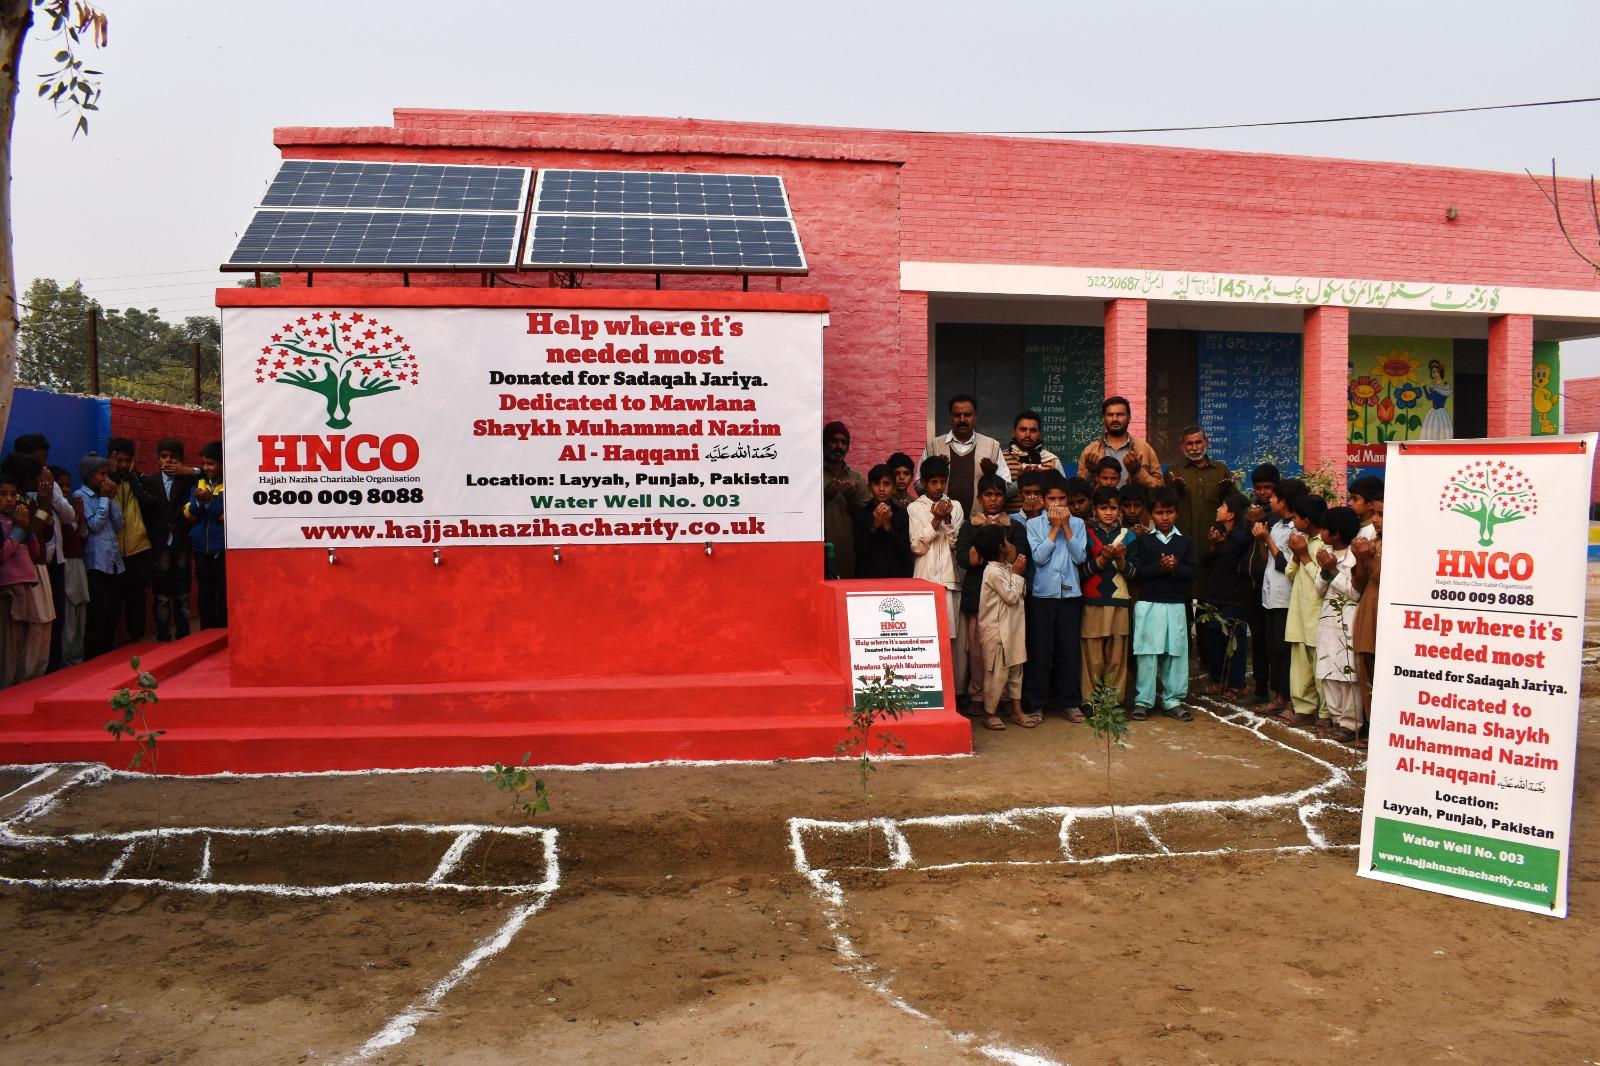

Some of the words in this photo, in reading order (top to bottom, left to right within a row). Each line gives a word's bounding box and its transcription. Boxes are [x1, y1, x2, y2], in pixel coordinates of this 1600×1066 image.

[526, 313, 598, 340] Help
[604, 315, 695, 336] where
[701, 313, 743, 336] it's
[546, 343, 649, 364] needed
[654, 346, 724, 364] most
[489, 371, 574, 385] Donated
[578, 371, 610, 385] for
[614, 371, 697, 389] Sadaqah
[700, 371, 768, 390] Jariya.
[1044, 384, 1064, 392] 1122
[1048, 374, 1061, 384] 15
[499, 393, 617, 411] Dedicated
[621, 395, 645, 411] to
[650, 394, 756, 411] Mawlana
[1043, 394, 1062, 403] 1124
[473, 419, 562, 440] Shaykh
[566, 419, 703, 436] Muhammad
[708, 419, 781, 436] Nazim
[258, 434, 419, 472] HNCO
[558, 444, 586, 461] Al
[603, 443, 699, 465] Haqqani
[259, 476, 287, 485] Hajjah
[366, 475, 420, 484] Organisation
[467, 474, 554, 486] Location:
[560, 474, 629, 488] Layyah,
[636, 473, 704, 487] Punjab,
[710, 473, 789, 485] Pakistan
[253, 489, 313, 505] 0800
[318, 490, 363, 505] 009
[367, 488, 424, 504] 8088
[530, 494, 596, 508] Water
[603, 494, 651, 508] Well
[659, 495, 696, 507] No.
[703, 495, 740, 507] 003
[301, 517, 765, 543] www.hajjahnazihacharity.co.uk
[1436, 550, 1533, 581] HNCO
[1431, 589, 1466, 601] 0800
[1469, 592, 1496, 604] 009
[1499, 593, 1534, 606] 8088
[880, 622, 906, 630] HNCO
[1404, 610, 1453, 636] Help
[1457, 617, 1525, 638] where
[1529, 620, 1562, 641] it's
[1415, 643, 1487, 663] needed
[1492, 651, 1545, 668] most
[1393, 666, 1442, 680] Donated
[1445, 671, 1464, 683] for
[1467, 673, 1519, 690] Sadaqah
[1522, 679, 1567, 695] Jariya.
[1418, 691, 1506, 714] Dedicated
[1512, 703, 1531, 717] to
[1400, 711, 1476, 734] Mawlana
[1483, 722, 1549, 745] Shaykh
[1389, 733, 1492, 761] Muhammad
[1499, 748, 1558, 770] Nazim
[1396, 757, 1496, 785] Al-Haqqani
[1436, 791, 1498, 810] Location:
[1383, 800, 1432, 818] Layyah,
[1437, 809, 1486, 829] Punjab,
[1492, 819, 1554, 839] Pakistan
[1403, 833, 1440, 848] Water
[1443, 841, 1471, 854] Well
[1475, 847, 1496, 859] No.
[1499, 851, 1524, 864] 003
[1378, 851, 1549, 894] www.hajjahnazihacharity.co.uk
